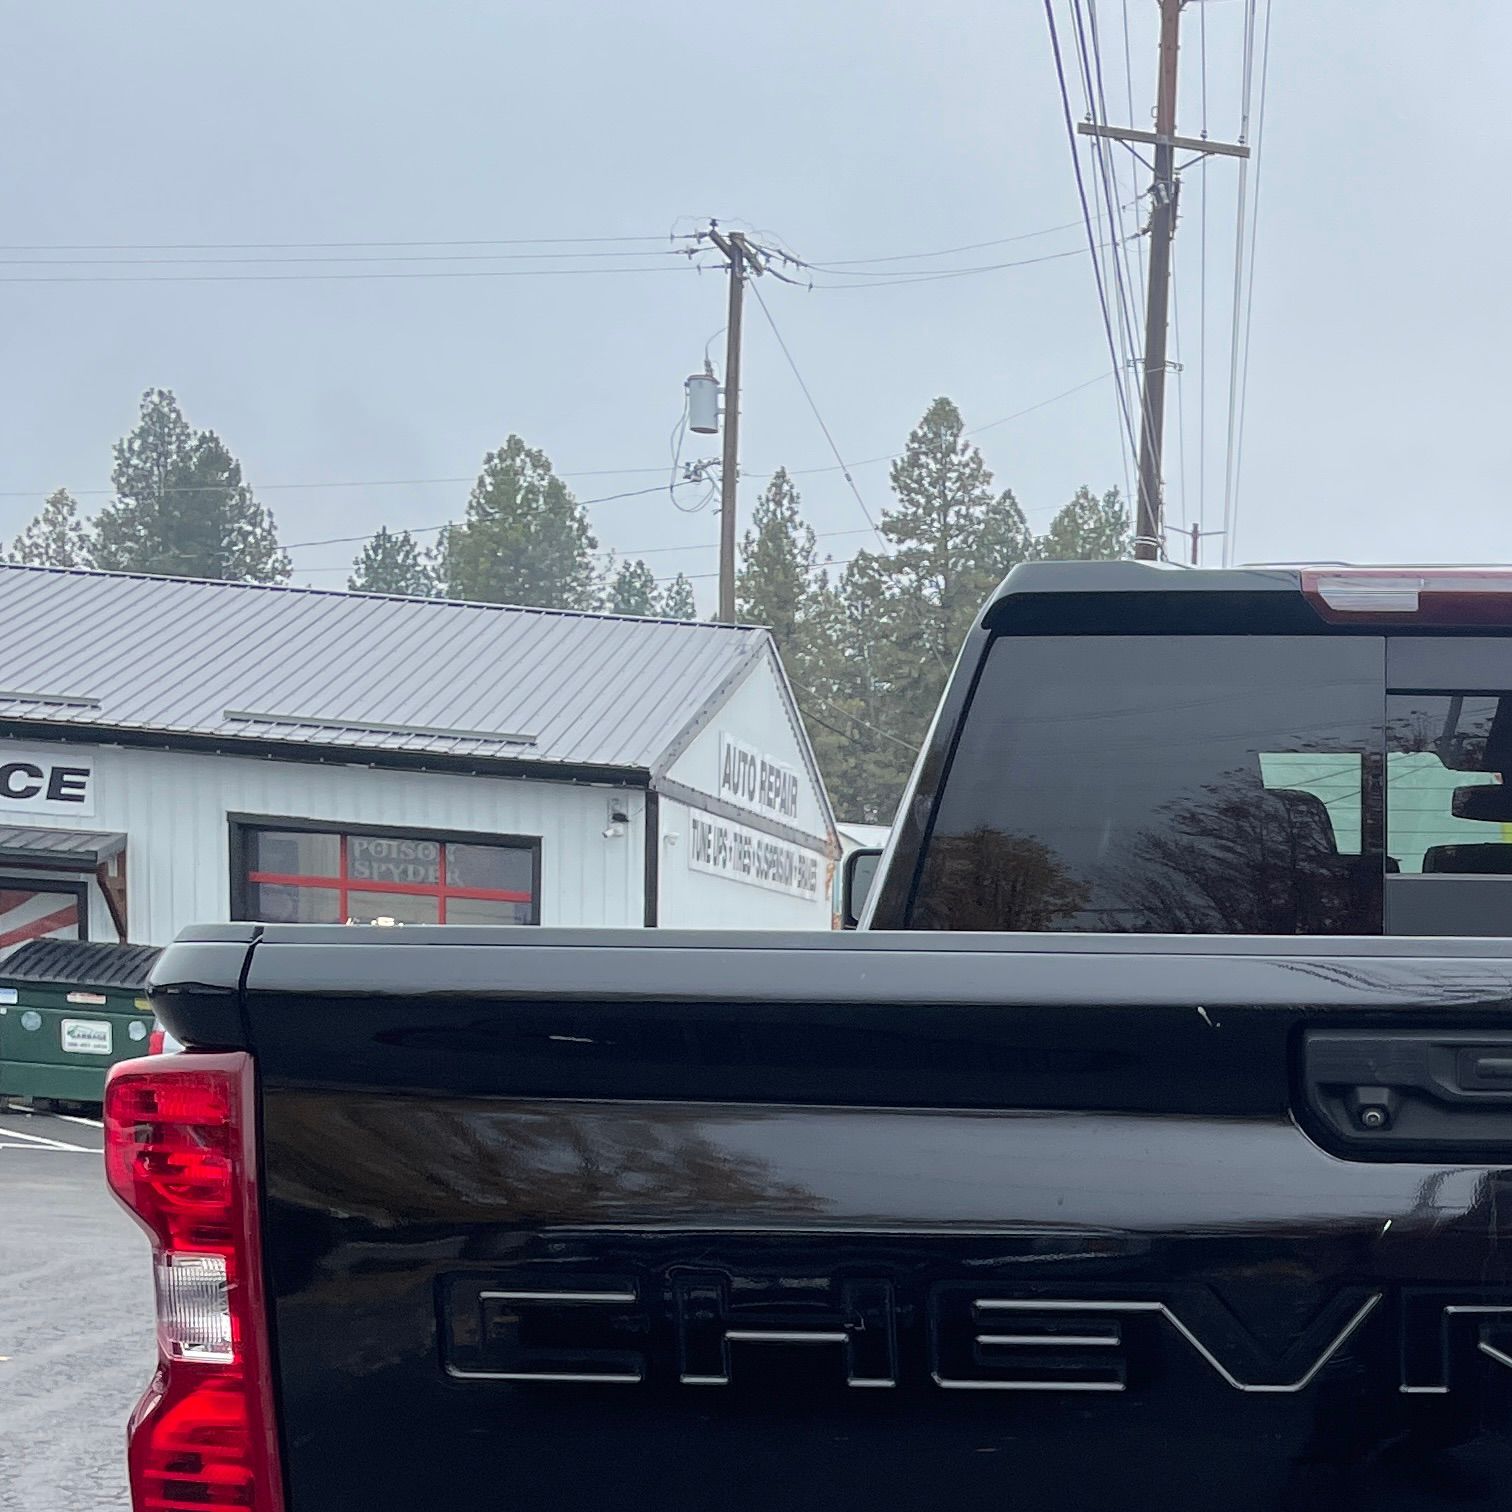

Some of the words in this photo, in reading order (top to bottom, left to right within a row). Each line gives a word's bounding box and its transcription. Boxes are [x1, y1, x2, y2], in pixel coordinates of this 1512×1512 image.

[722, 743, 757, 802] AUTO
[758, 759, 798, 819] REPAIR
[353, 839, 457, 863] POISON
[692, 818, 712, 864] TUNE
[354, 861, 464, 887] SPYDER
